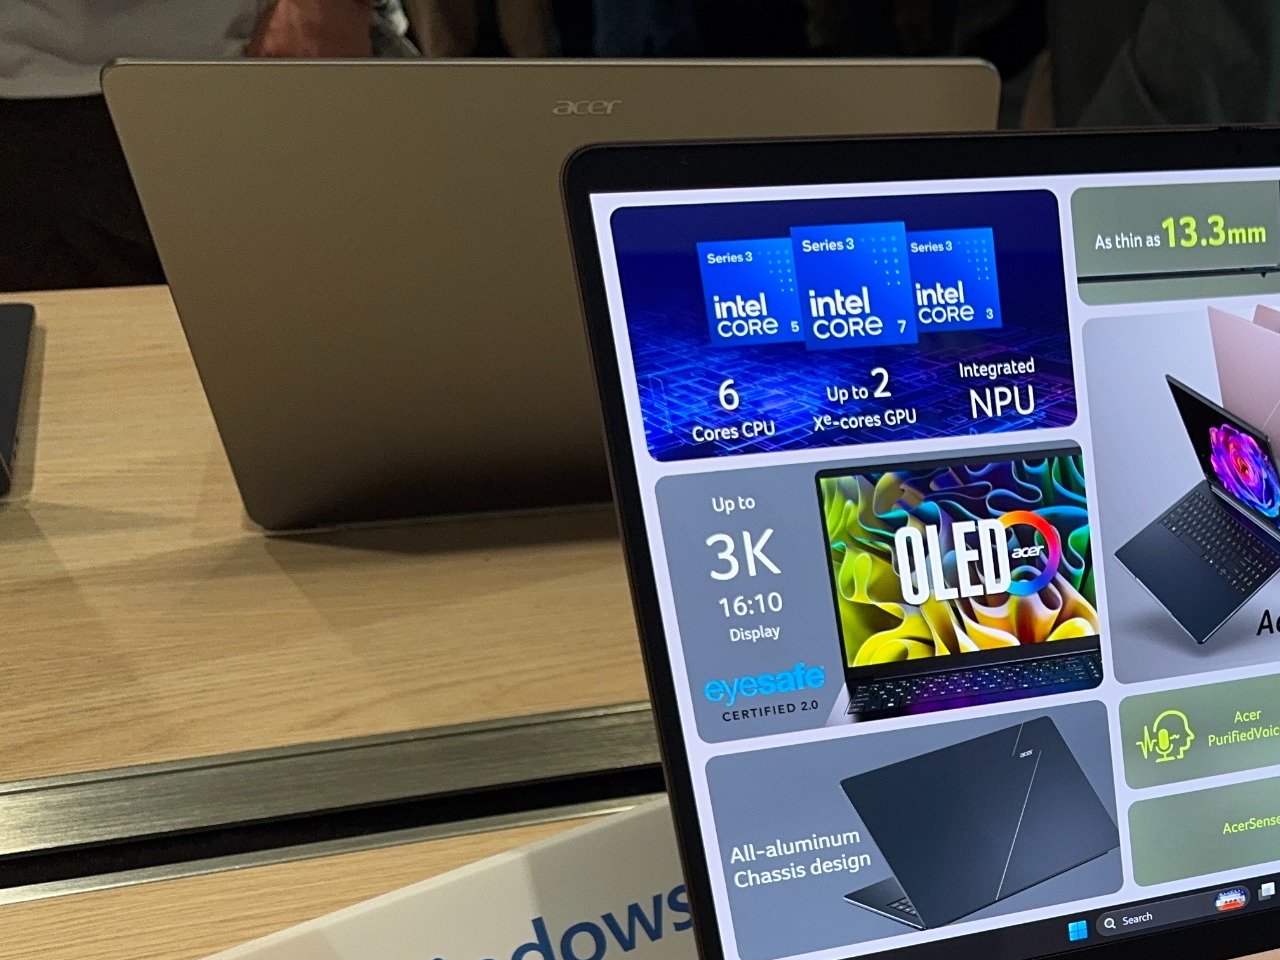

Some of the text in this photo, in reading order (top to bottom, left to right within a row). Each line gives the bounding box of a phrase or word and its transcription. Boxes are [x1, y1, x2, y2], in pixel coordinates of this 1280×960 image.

[552, 99, 623, 116] acer
[1095, 213, 1267, 250] As thin as 13.3mm
[802, 236, 855, 253] Series 3
[910, 239, 953, 253] Series 3
[707, 250, 753, 264] Series 3
[808, 286, 871, 318] intel
[915, 280, 965, 307] intel
[713, 292, 768, 319] intel
[986, 307, 994, 320] 3
[790, 320, 800, 334] 5
[897, 318, 907, 335] 7
[958, 356, 1036, 381] Integrated
[718, 377, 740, 410] 6
[826, 366, 892, 405] Up to 2
[968, 384, 1036, 420] NPU
[883, 407, 918, 427] GPU
[691, 419, 776, 442] Cores CPU
[711, 494, 755, 514] Up to
[705, 527, 782, 582] 3K
[894, 518, 1013, 607] OLED
[1011, 543, 1045, 559] acer
[718, 590, 783, 619] 16:10
[729, 623, 781, 645] Display
[704, 662, 825, 707] eyesafe
[721, 699, 819, 723] CERTIFIED 2.0
[1233, 708, 1262, 724] Acer
[1018, 748, 1034, 759] acer
[730, 828, 861, 864] All-aluminum
[733, 851, 871, 889] Chassis design
[1121, 910, 1154, 926] Search
